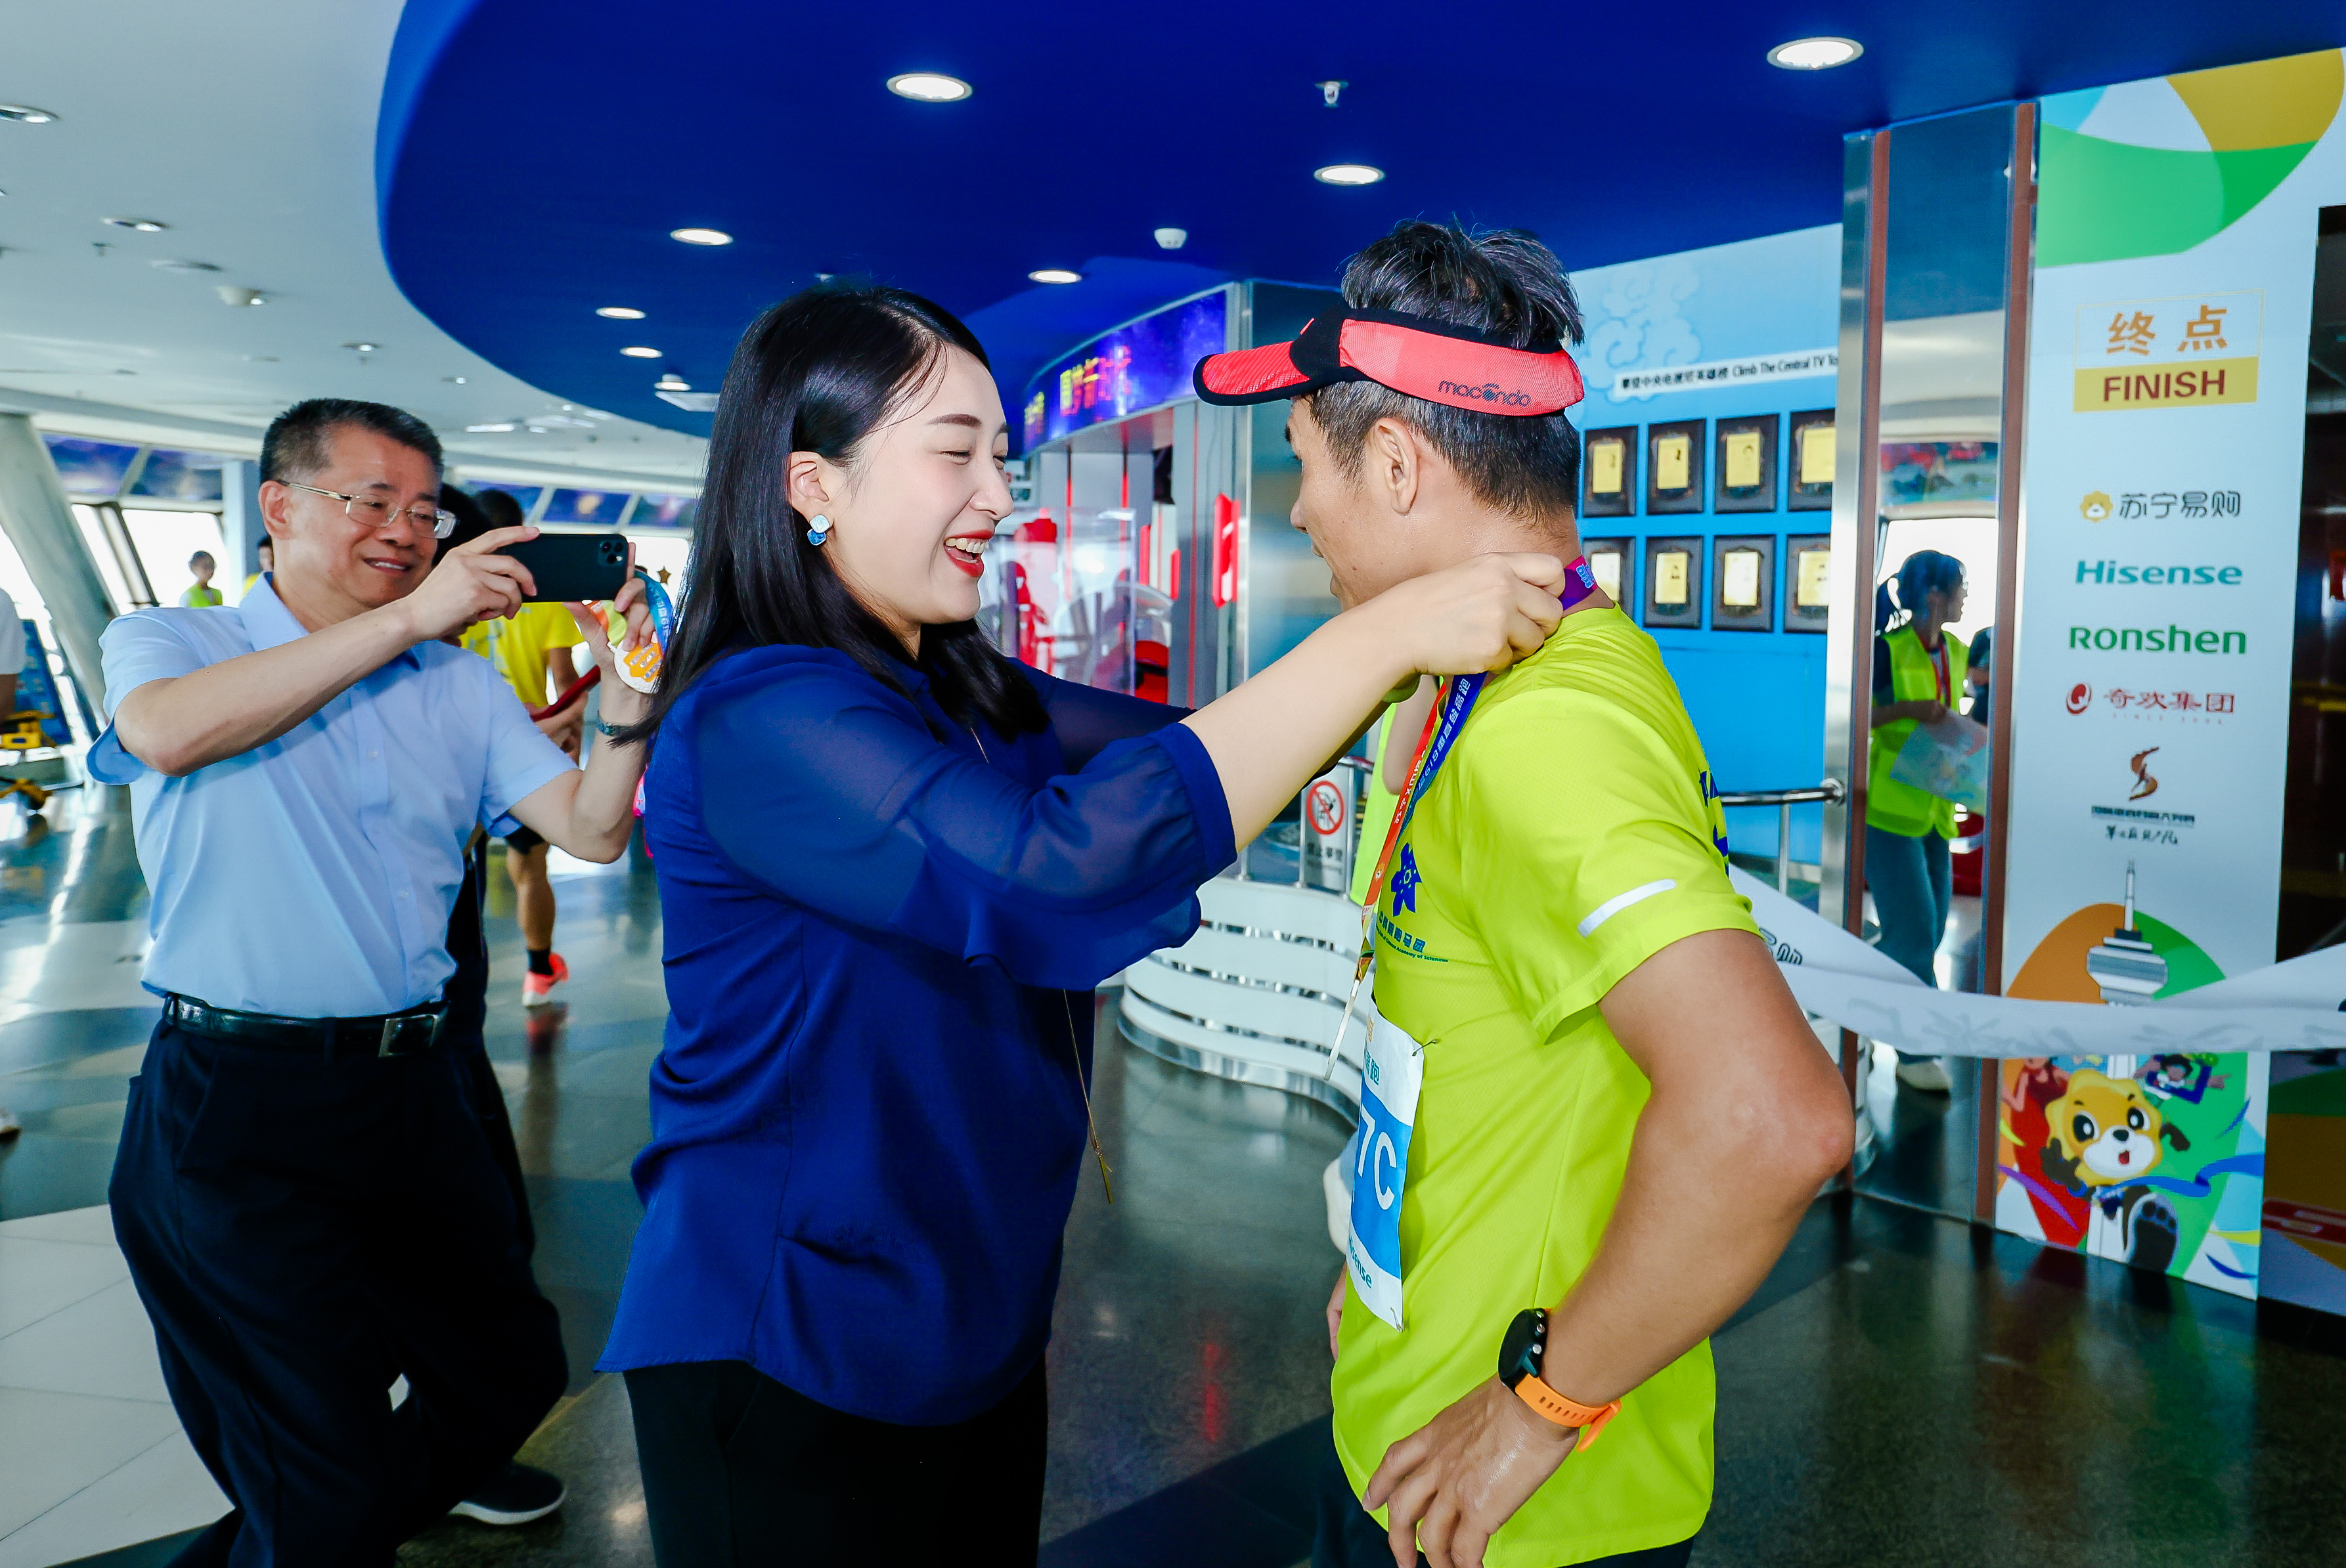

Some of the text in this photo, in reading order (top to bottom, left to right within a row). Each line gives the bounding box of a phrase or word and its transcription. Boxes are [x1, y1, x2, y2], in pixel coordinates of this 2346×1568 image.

[2106, 303, 2228, 357] 终点
[1732, 363, 1757, 378] Climb
[1761, 361, 1775, 373] The
[1778, 358, 1809, 372] Central
[1813, 355, 1826, 368] TV
[1438, 380, 1531, 407] macondo
[2103, 369, 2226, 402] FINISH
[2119, 490, 2241, 519] 苏宁易购
[2075, 560, 2244, 586] Hisense
[2069, 624, 2247, 655] Ronshen
[1396, 947, 1417, 959] Academy
[1348, 1231, 1372, 1289] Hisense
